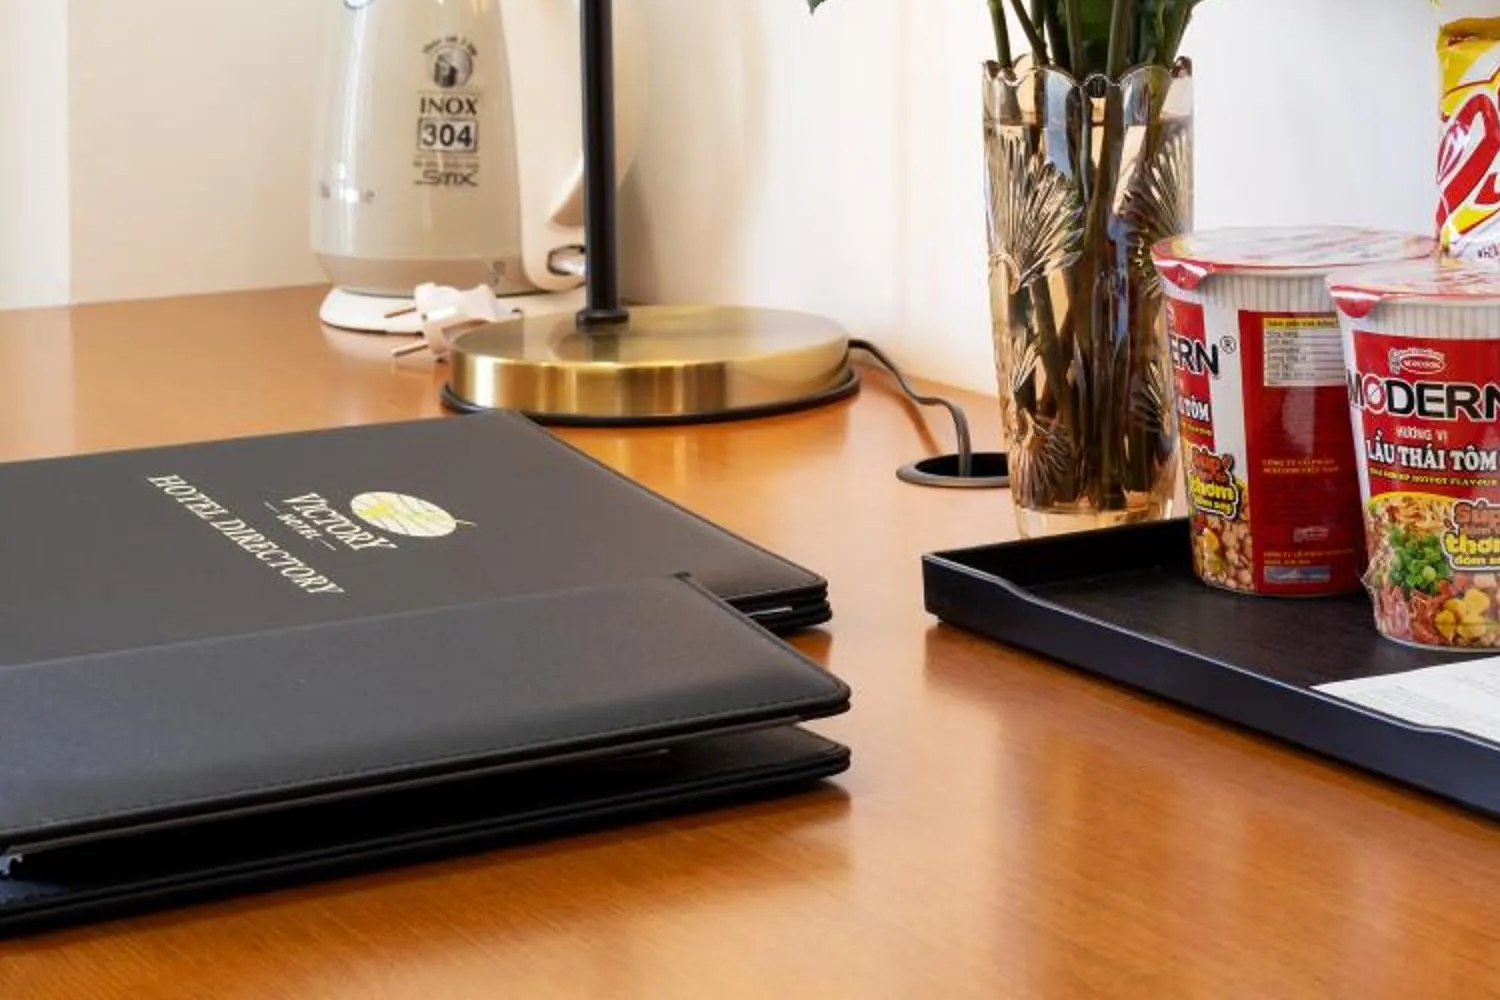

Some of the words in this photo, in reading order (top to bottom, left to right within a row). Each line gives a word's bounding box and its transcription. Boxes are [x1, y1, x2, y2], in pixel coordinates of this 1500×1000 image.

[419, 97, 478, 116] INOX
[422, 123, 473, 148] 304
[1397, 443, 1447, 470] THÁI
[1449, 444, 1497, 472] TÔM
[147, 475, 229, 521] HOTEL
[209, 519, 345, 593] DIRECTORY
[282, 492, 398, 550] VICTORY
